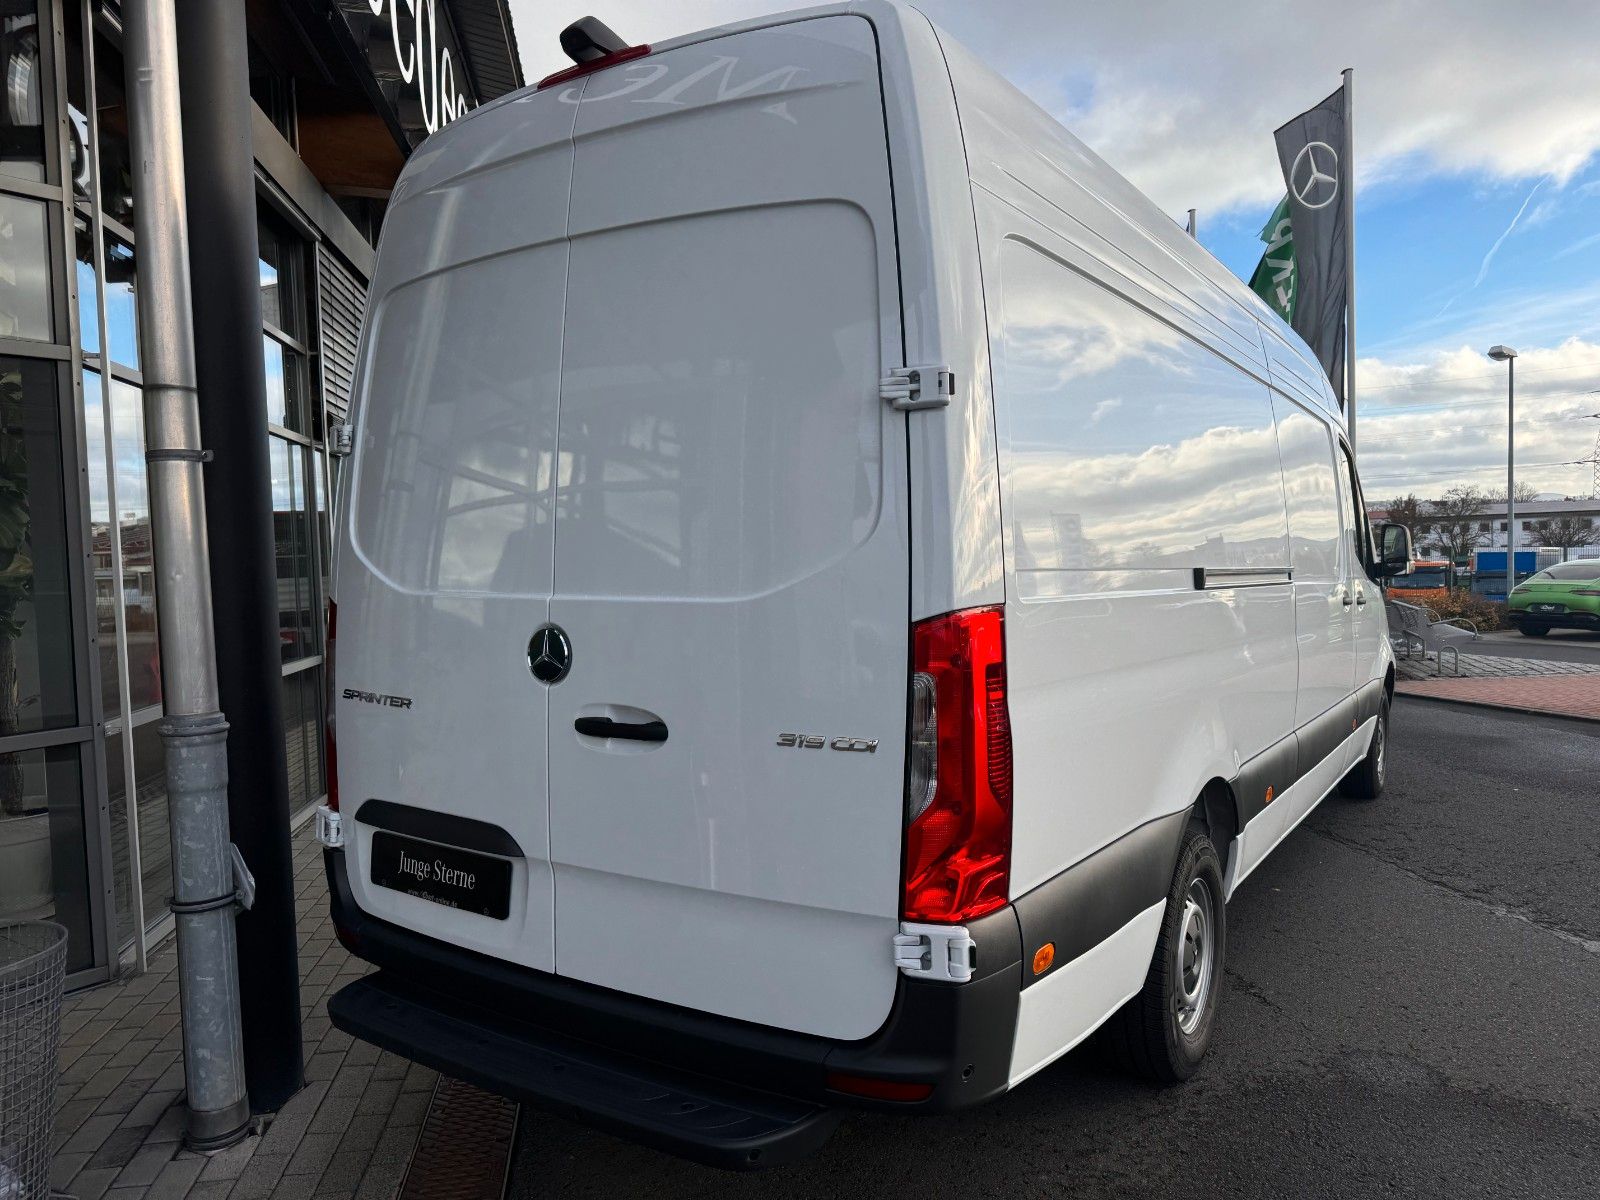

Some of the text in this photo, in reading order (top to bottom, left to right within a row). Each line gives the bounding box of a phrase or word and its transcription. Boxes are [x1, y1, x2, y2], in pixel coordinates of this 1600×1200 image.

[342, 688, 413, 709] SPRINTER
[776, 733, 826, 749] 319
[397, 850, 476, 890] Junge Sterne
